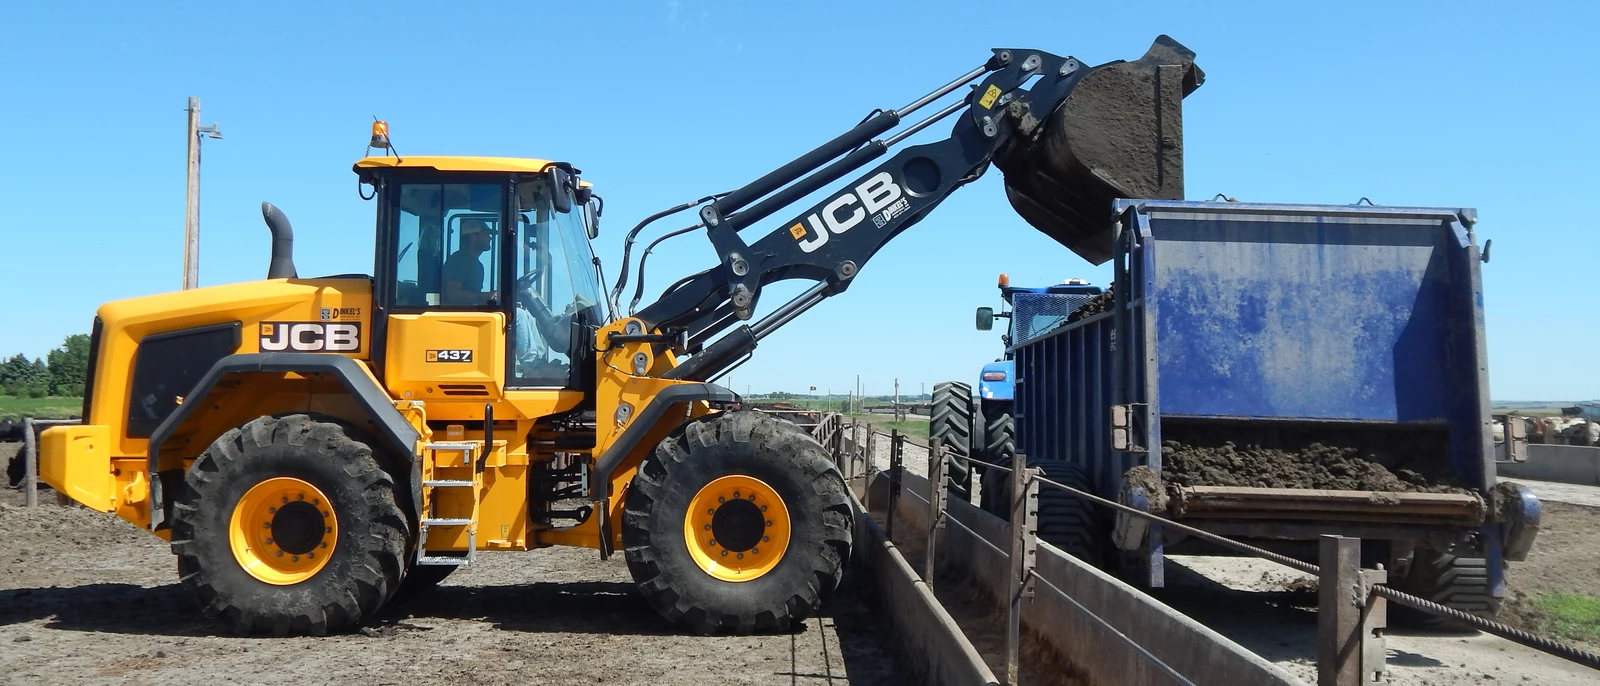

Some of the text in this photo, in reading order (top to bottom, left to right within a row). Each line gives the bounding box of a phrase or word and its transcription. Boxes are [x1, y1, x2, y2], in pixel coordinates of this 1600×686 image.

[798, 171, 902, 253] JCB
[332, 307, 361, 319] DINKEL'S
[261, 324, 359, 350] JCB
[438, 350, 471, 360] 437
